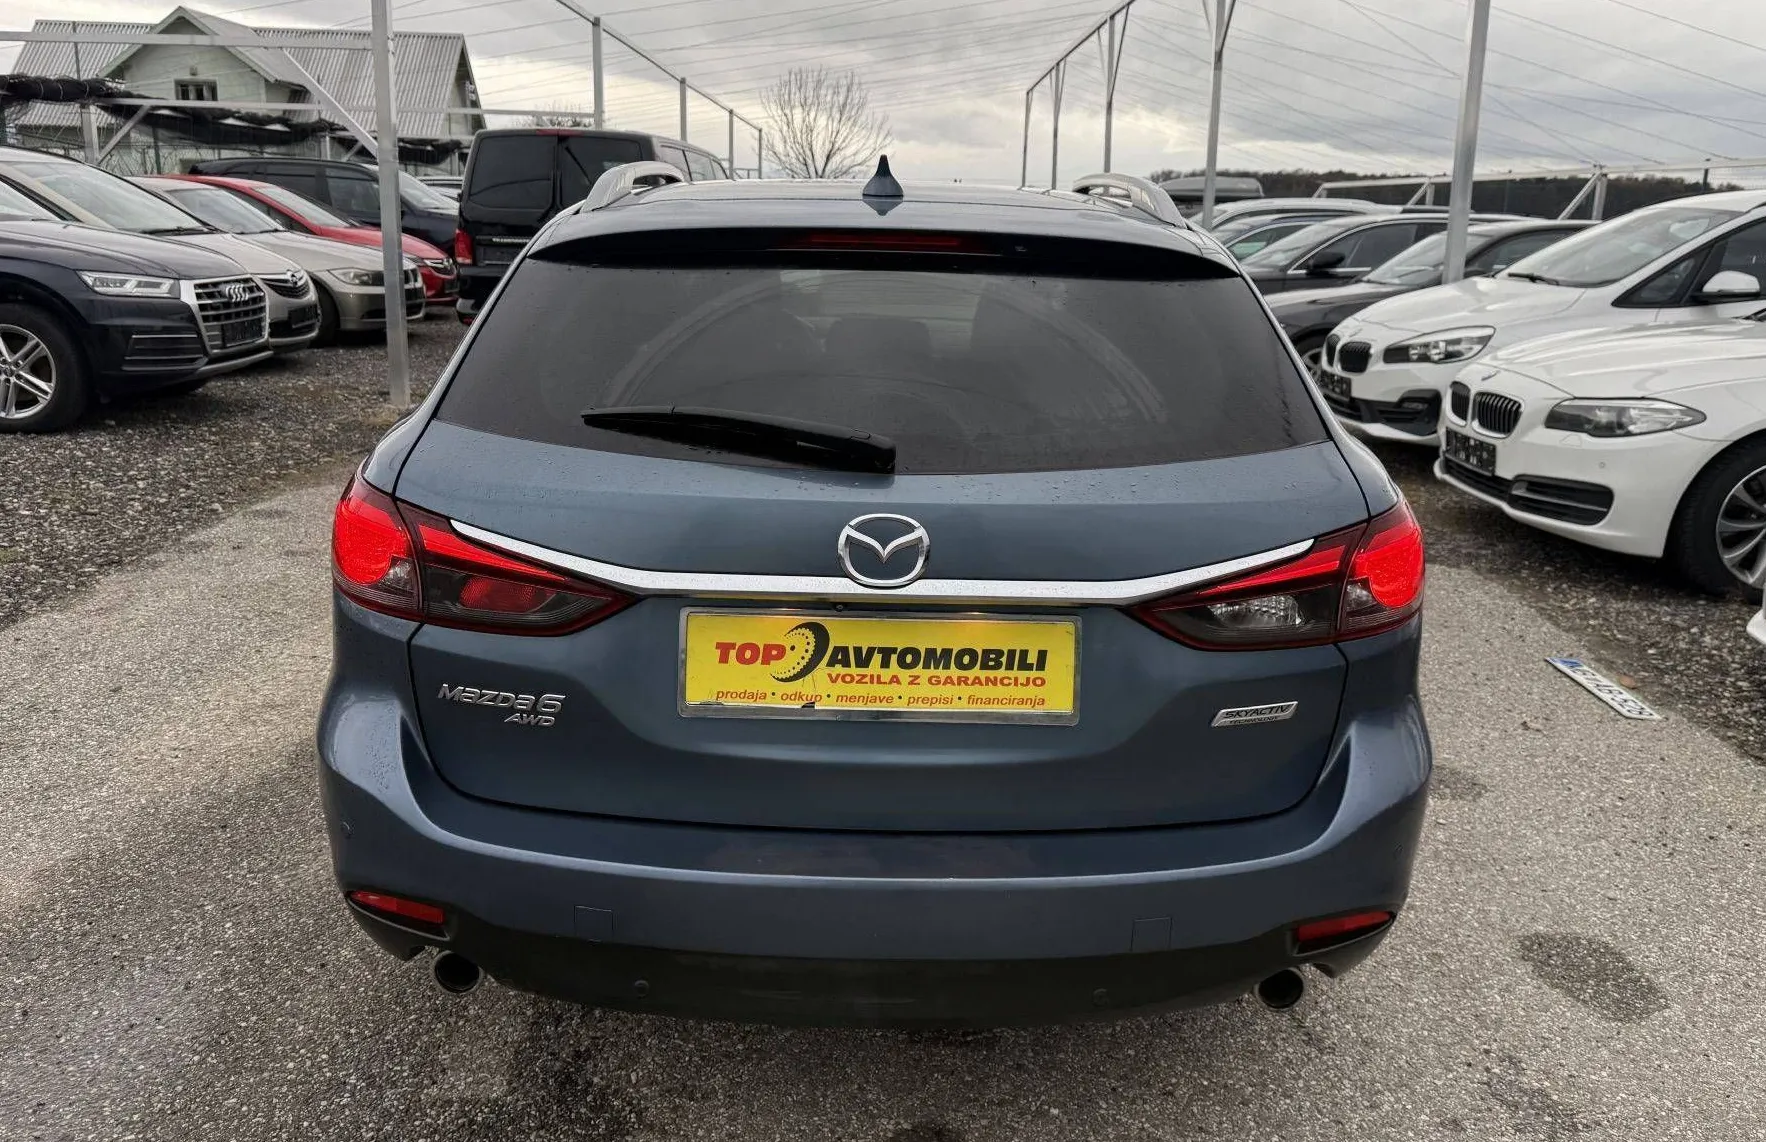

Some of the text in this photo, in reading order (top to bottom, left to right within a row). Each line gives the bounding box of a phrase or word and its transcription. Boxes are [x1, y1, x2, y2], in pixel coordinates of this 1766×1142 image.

[715, 642, 1048, 671] TOP AVTOMOBILI
[827, 673, 1046, 687] VOZILA Z GARANCIJO
[715, 690, 1046, 708] prodaja odkup menjave prepisi financiranja
[1224, 704, 1289, 718] SKYACTIV
[504, 713, 556, 727] AWD
